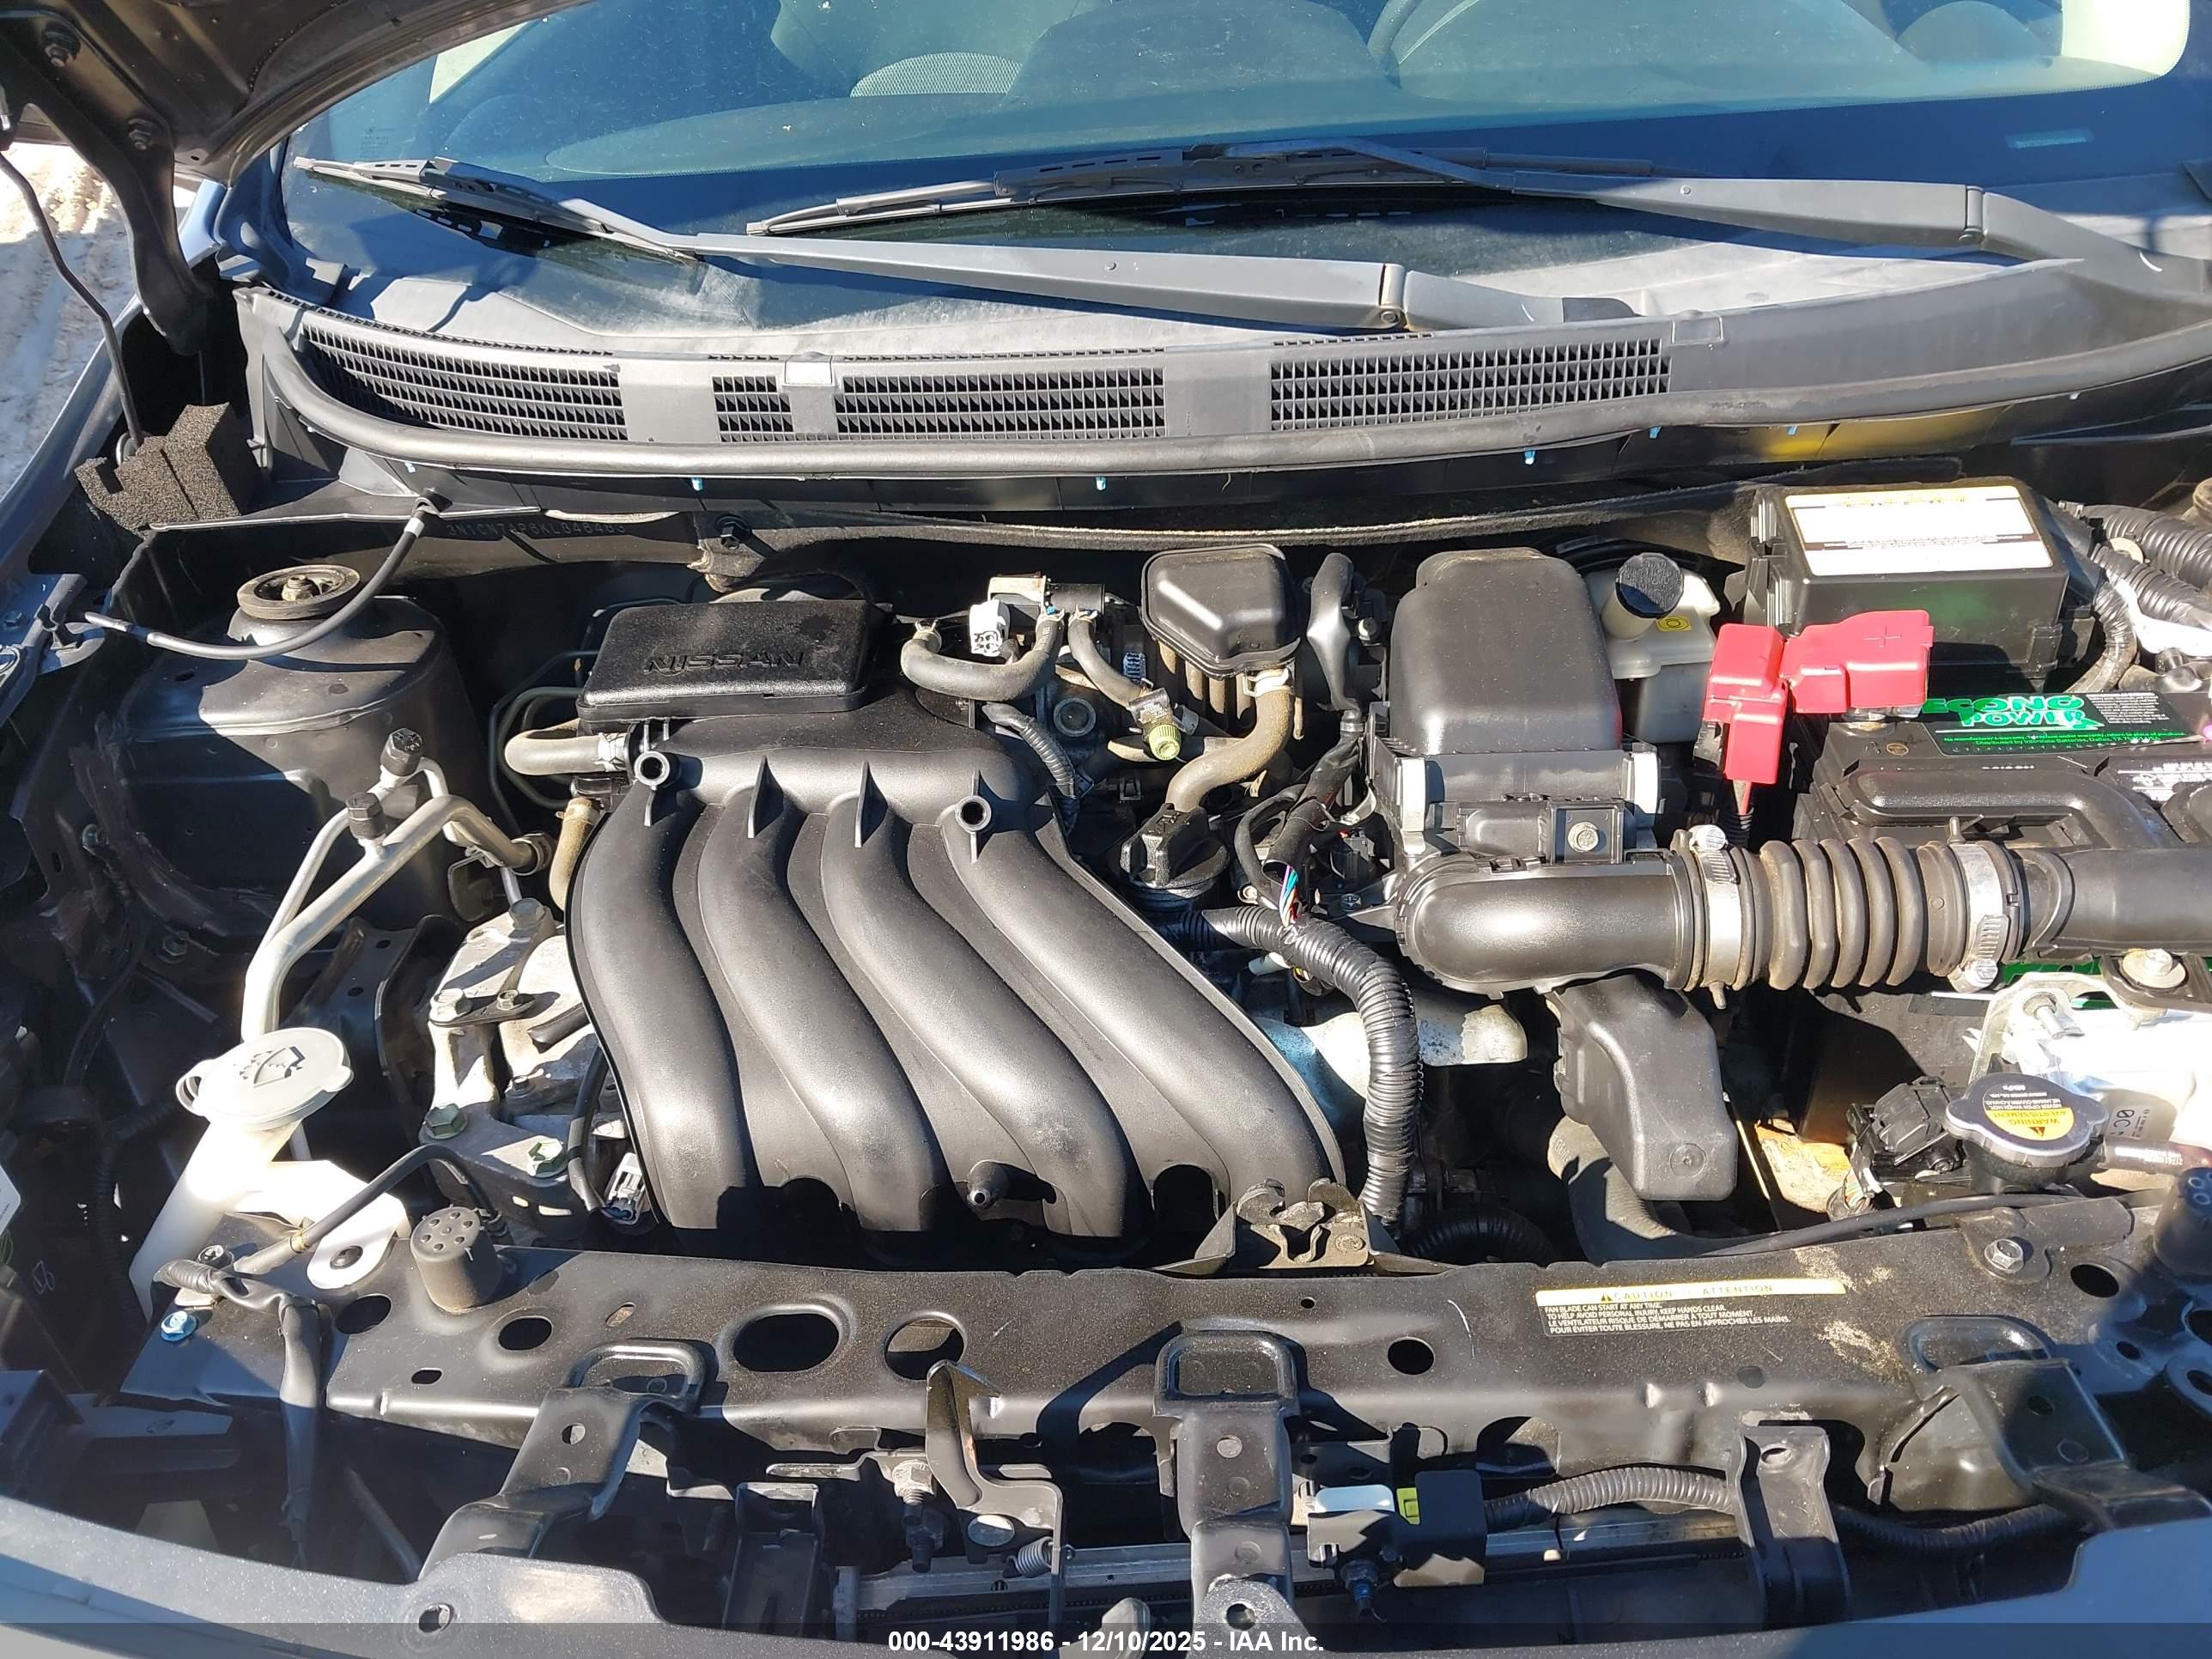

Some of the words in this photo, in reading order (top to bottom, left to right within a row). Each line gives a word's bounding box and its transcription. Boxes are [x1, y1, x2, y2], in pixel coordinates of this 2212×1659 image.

[643, 651, 805, 674] NISSAN
[1923, 695, 2084, 714] ECONO
[1959, 709, 2104, 730] POWER
[1614, 1291, 1673, 1300] CAUTION
[1703, 1285, 1772, 1296] ATTENTION
[1558, 1318, 1607, 1327] VENTILATEUR
[1608, 1316, 1635, 1325] RISQUE
[1649, 1314, 1689, 1323] DÉMARRER
[1690, 1311, 1698, 1320] À
[1718, 1310, 1756, 1318] MOMENT.
[1634, 1309, 1659, 1317] INJURY,
[1573, 1324, 1598, 1334] ÉVITER
[1625, 1322, 1663, 1331] BLESSURE,
[1703, 1317, 1749, 1327] APPROCHER
